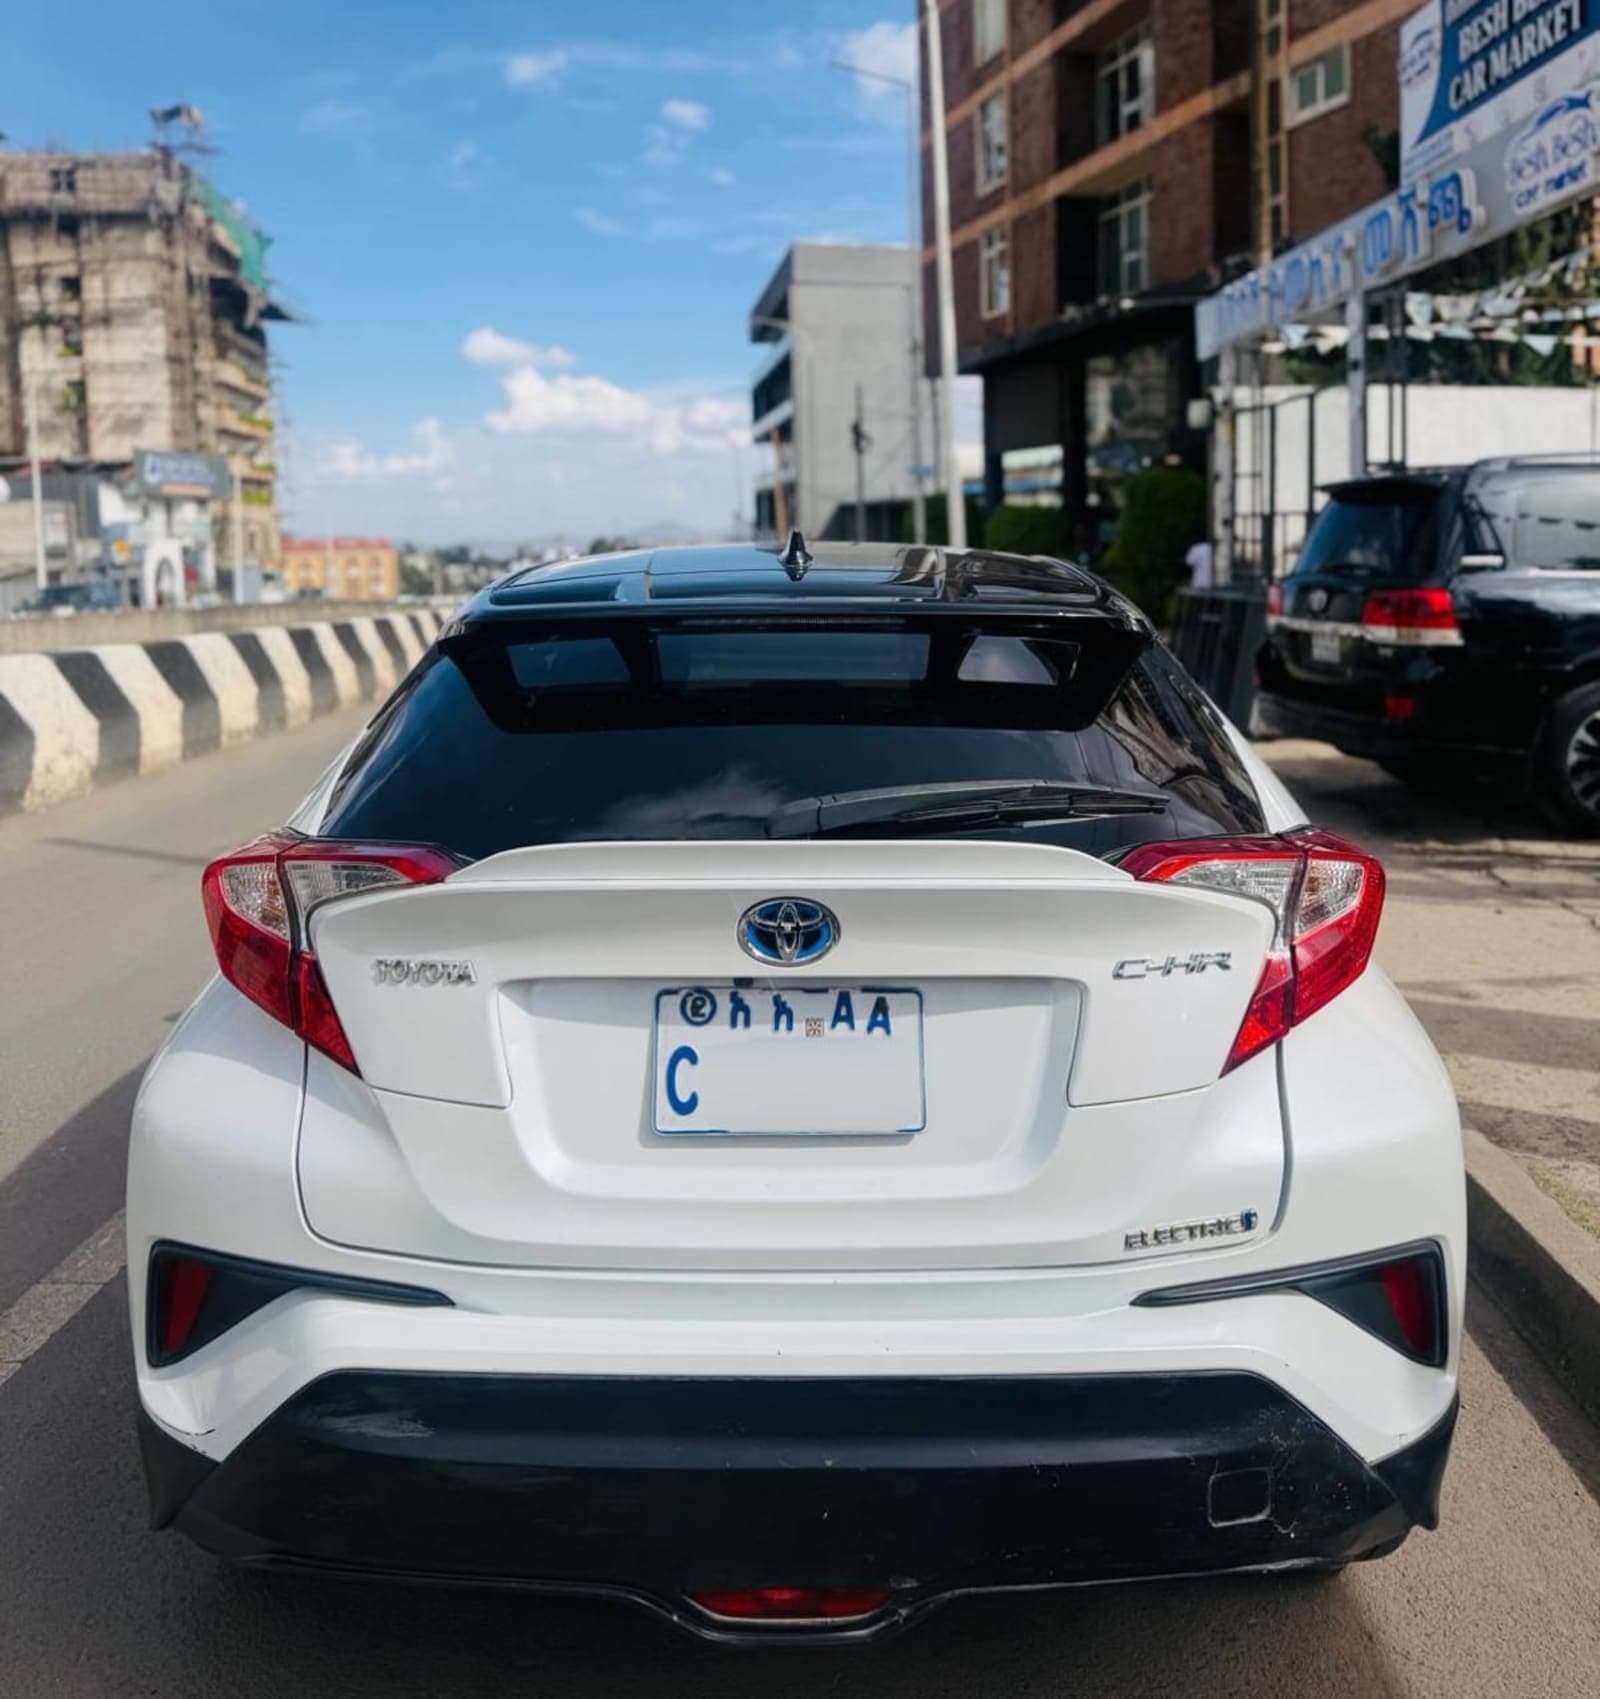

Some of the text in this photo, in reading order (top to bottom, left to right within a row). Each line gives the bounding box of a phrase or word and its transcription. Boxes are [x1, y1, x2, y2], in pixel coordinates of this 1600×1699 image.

[1449, 59, 1487, 111] CAR
[1489, 0, 1581, 86] MARKET
[1459, 0, 1508, 63] BESH
[374, 959, 477, 986] TOYOTA
[1111, 952, 1232, 980] C-HR
[665, 1045, 699, 1116] C
[1124, 1216, 1242, 1250] ELECTRIC
